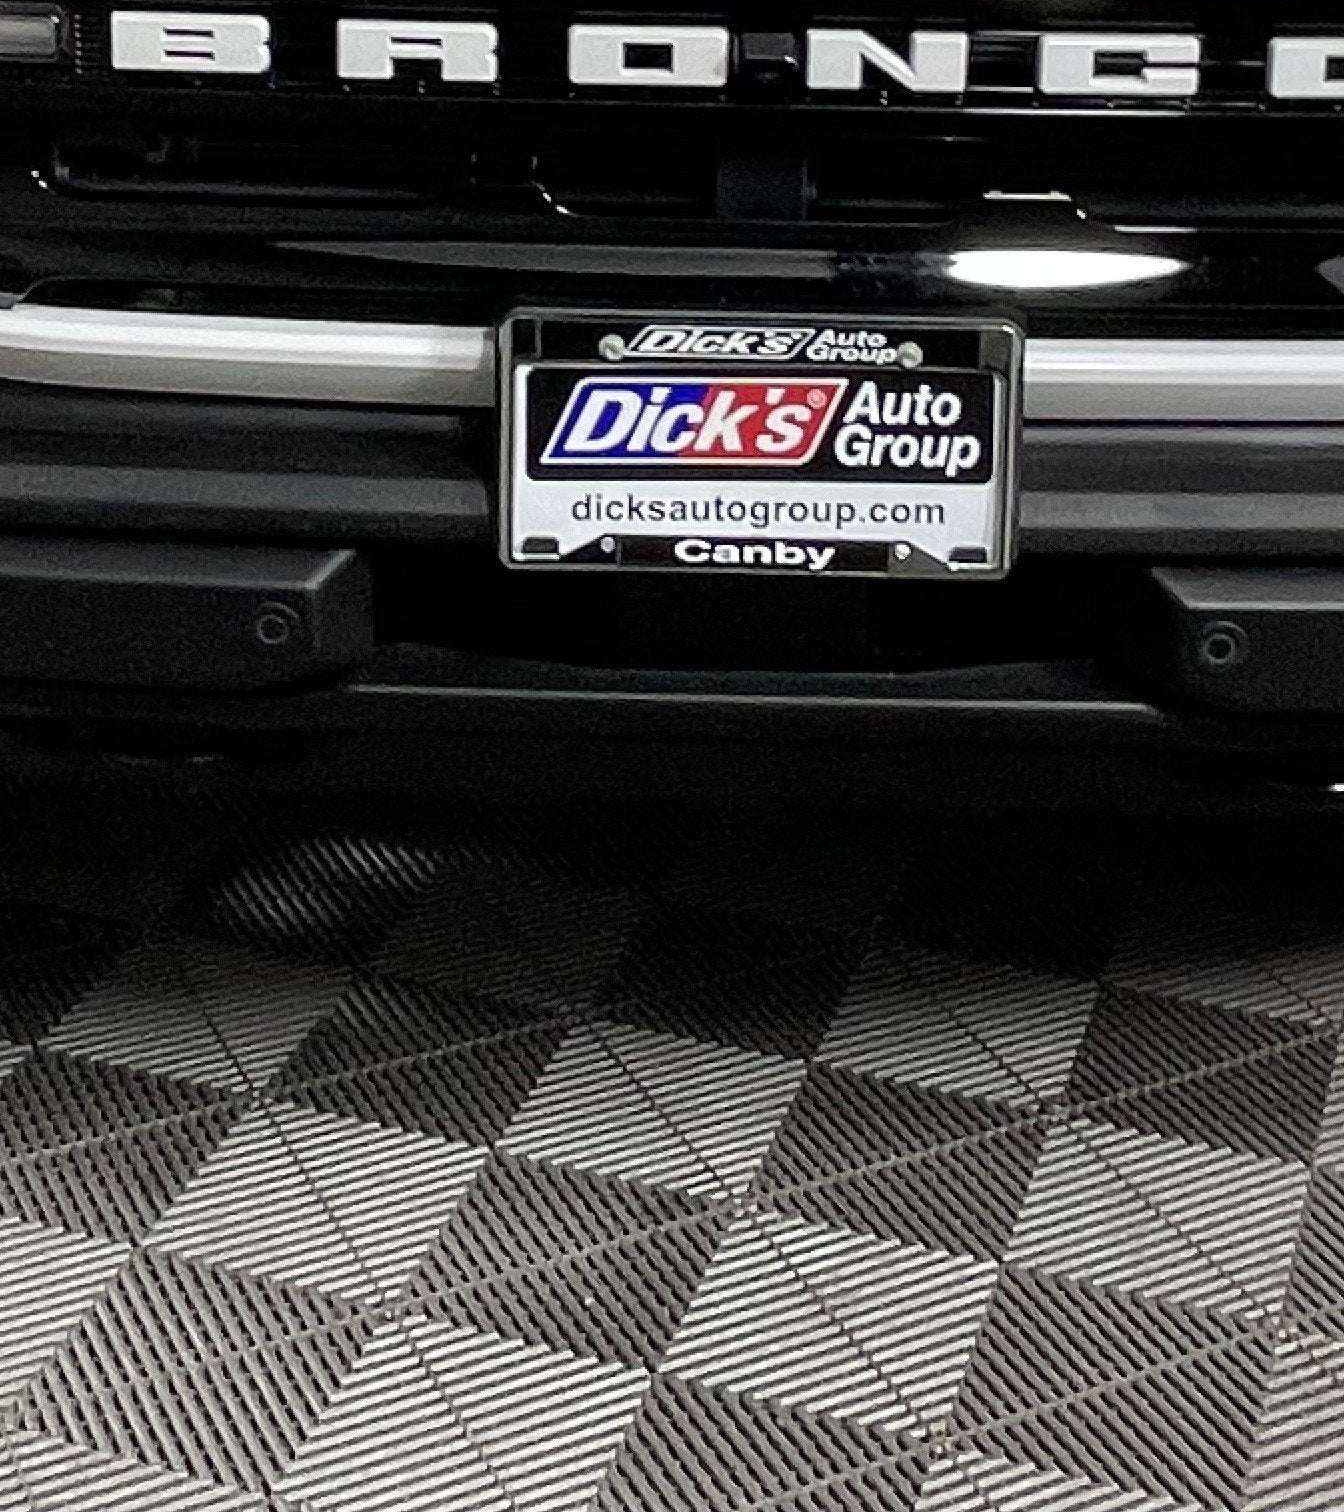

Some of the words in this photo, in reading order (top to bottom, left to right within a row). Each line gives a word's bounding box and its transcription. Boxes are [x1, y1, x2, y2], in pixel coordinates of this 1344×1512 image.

[806, 345, 898, 365] Group
[817, 329, 887, 347] Auto
[563, 387, 812, 453] Dick's
[843, 381, 963, 427] Auto
[833, 422, 981, 477] Group
[571, 493, 945, 529] dicksautogroup.com
[674, 539, 836, 570] Canby
